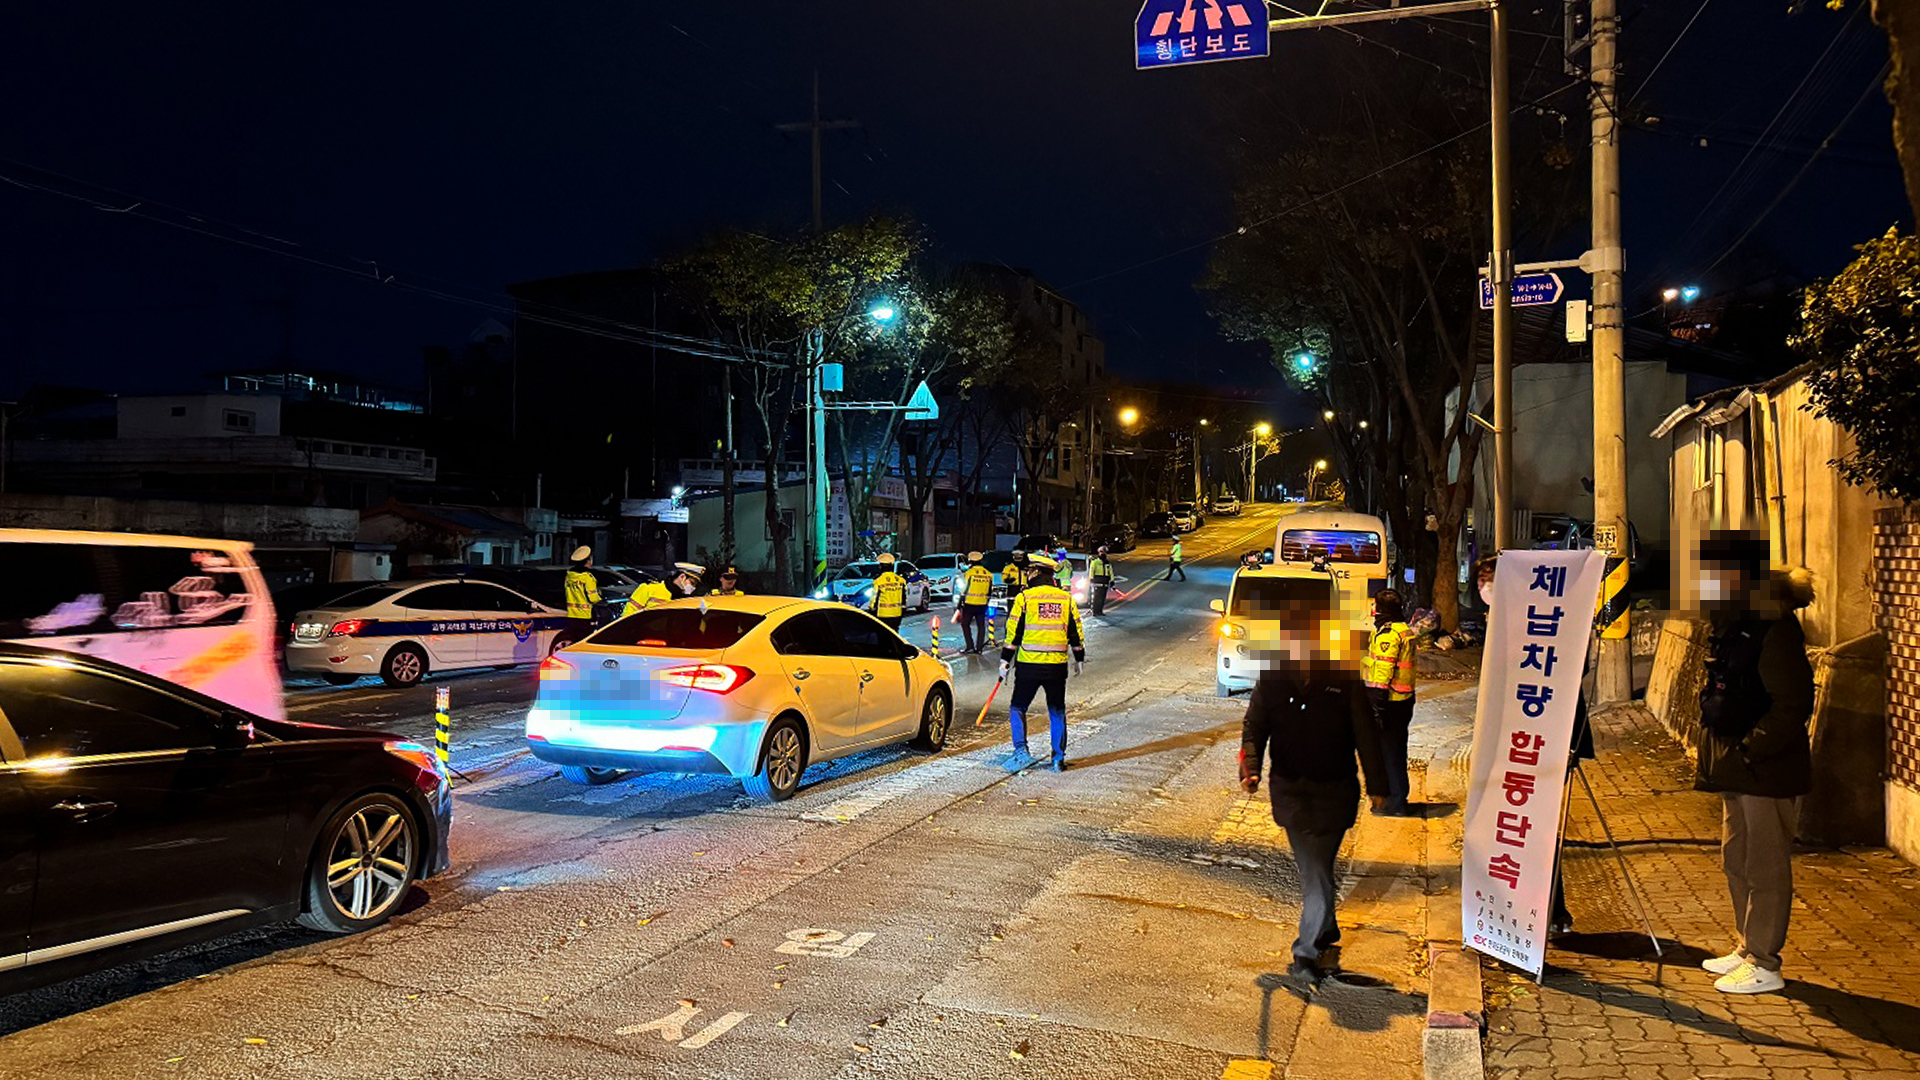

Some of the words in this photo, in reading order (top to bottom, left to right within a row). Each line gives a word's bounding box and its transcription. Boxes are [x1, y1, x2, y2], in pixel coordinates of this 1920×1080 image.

[1155, 34, 1251, 60] 횡단보도
[1516, 565, 1567, 717] 체납차량
[1488, 731, 1545, 890] 합동단속
